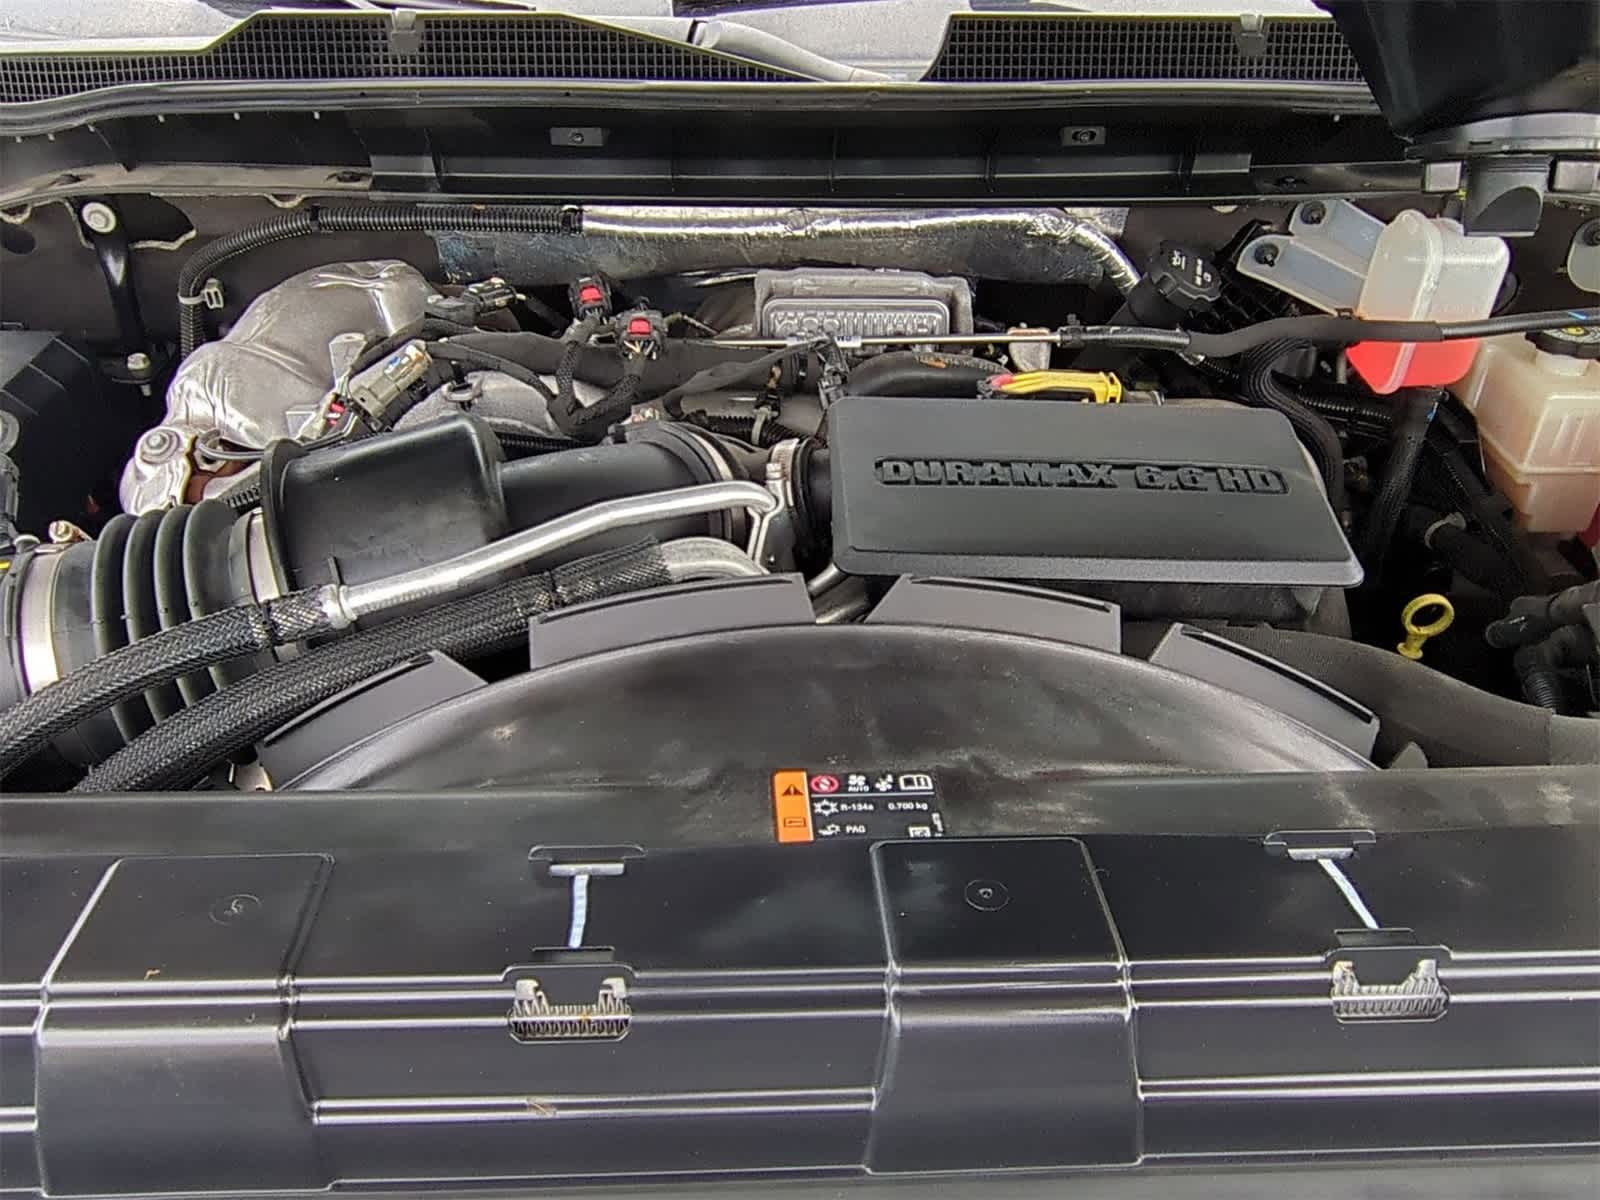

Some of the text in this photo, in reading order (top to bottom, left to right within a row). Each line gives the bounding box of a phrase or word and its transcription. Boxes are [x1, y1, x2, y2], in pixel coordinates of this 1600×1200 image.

[880, 459, 1288, 493] DURAMAX 6.6 HD
[888, 802, 914, 811] 0.700
